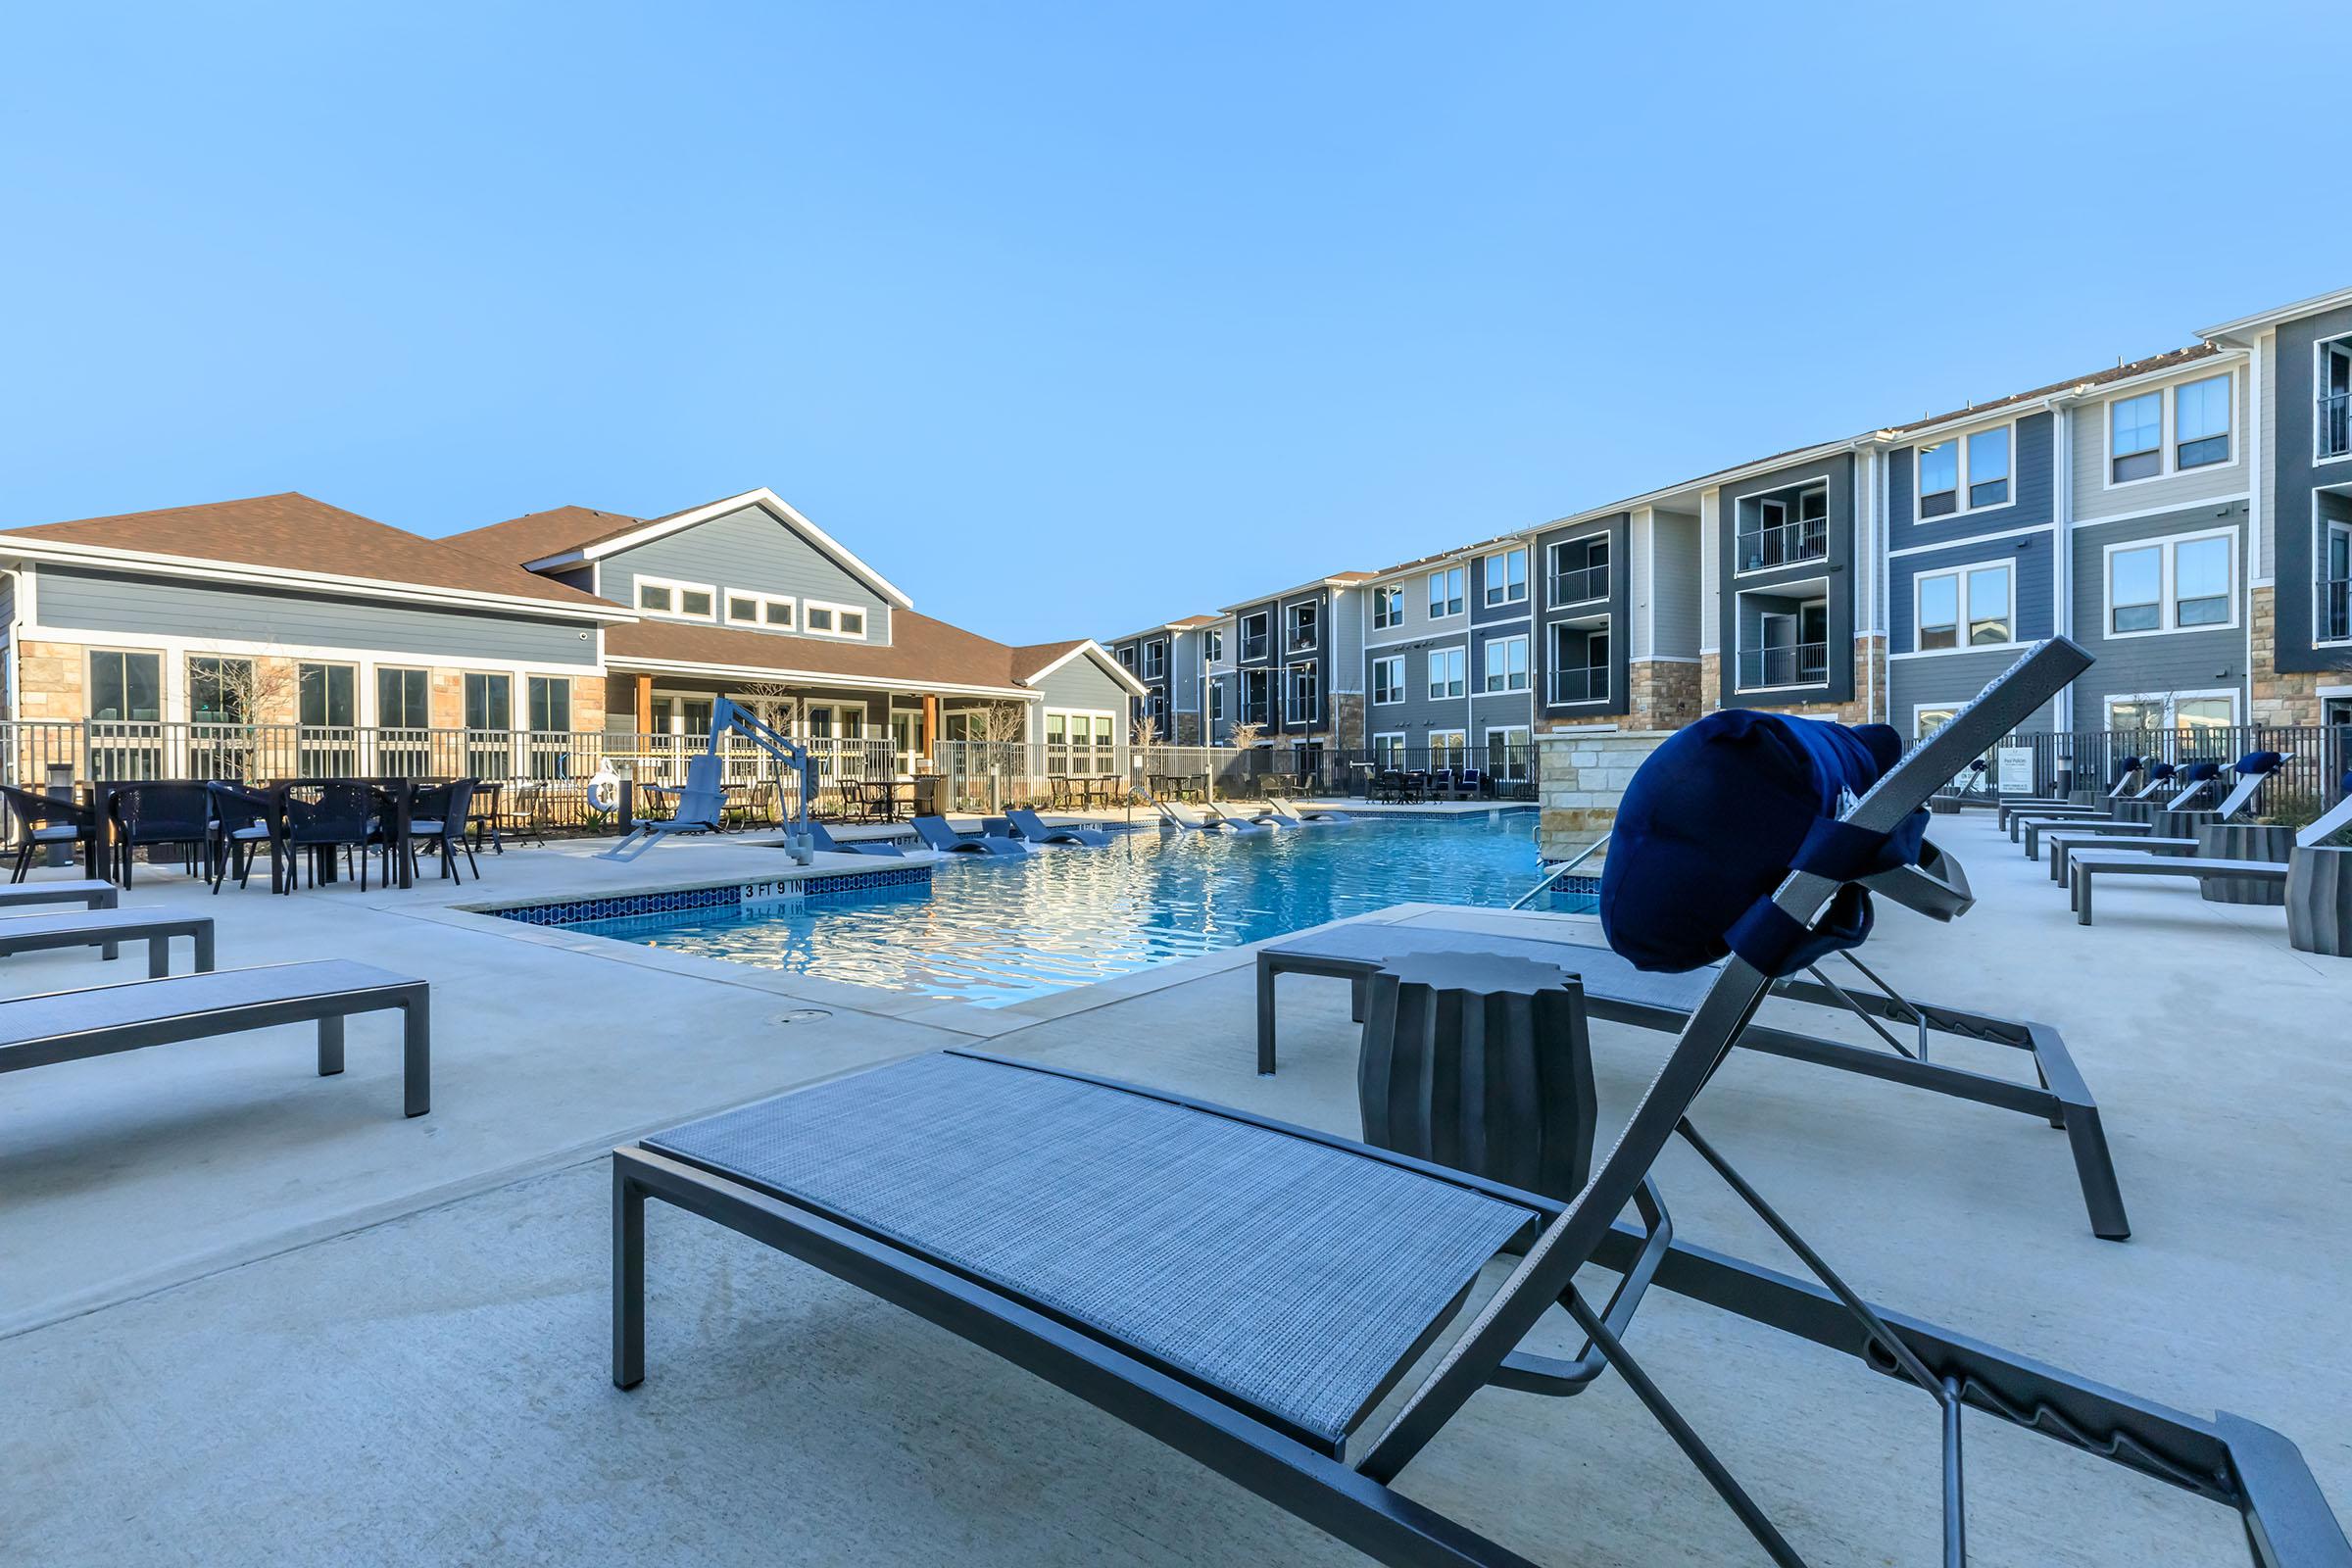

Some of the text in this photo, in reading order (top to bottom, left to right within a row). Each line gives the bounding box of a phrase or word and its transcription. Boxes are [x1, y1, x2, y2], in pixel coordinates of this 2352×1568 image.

[904, 836, 911, 845] FT
[746, 880, 803, 898] 3 FT 9 IN
